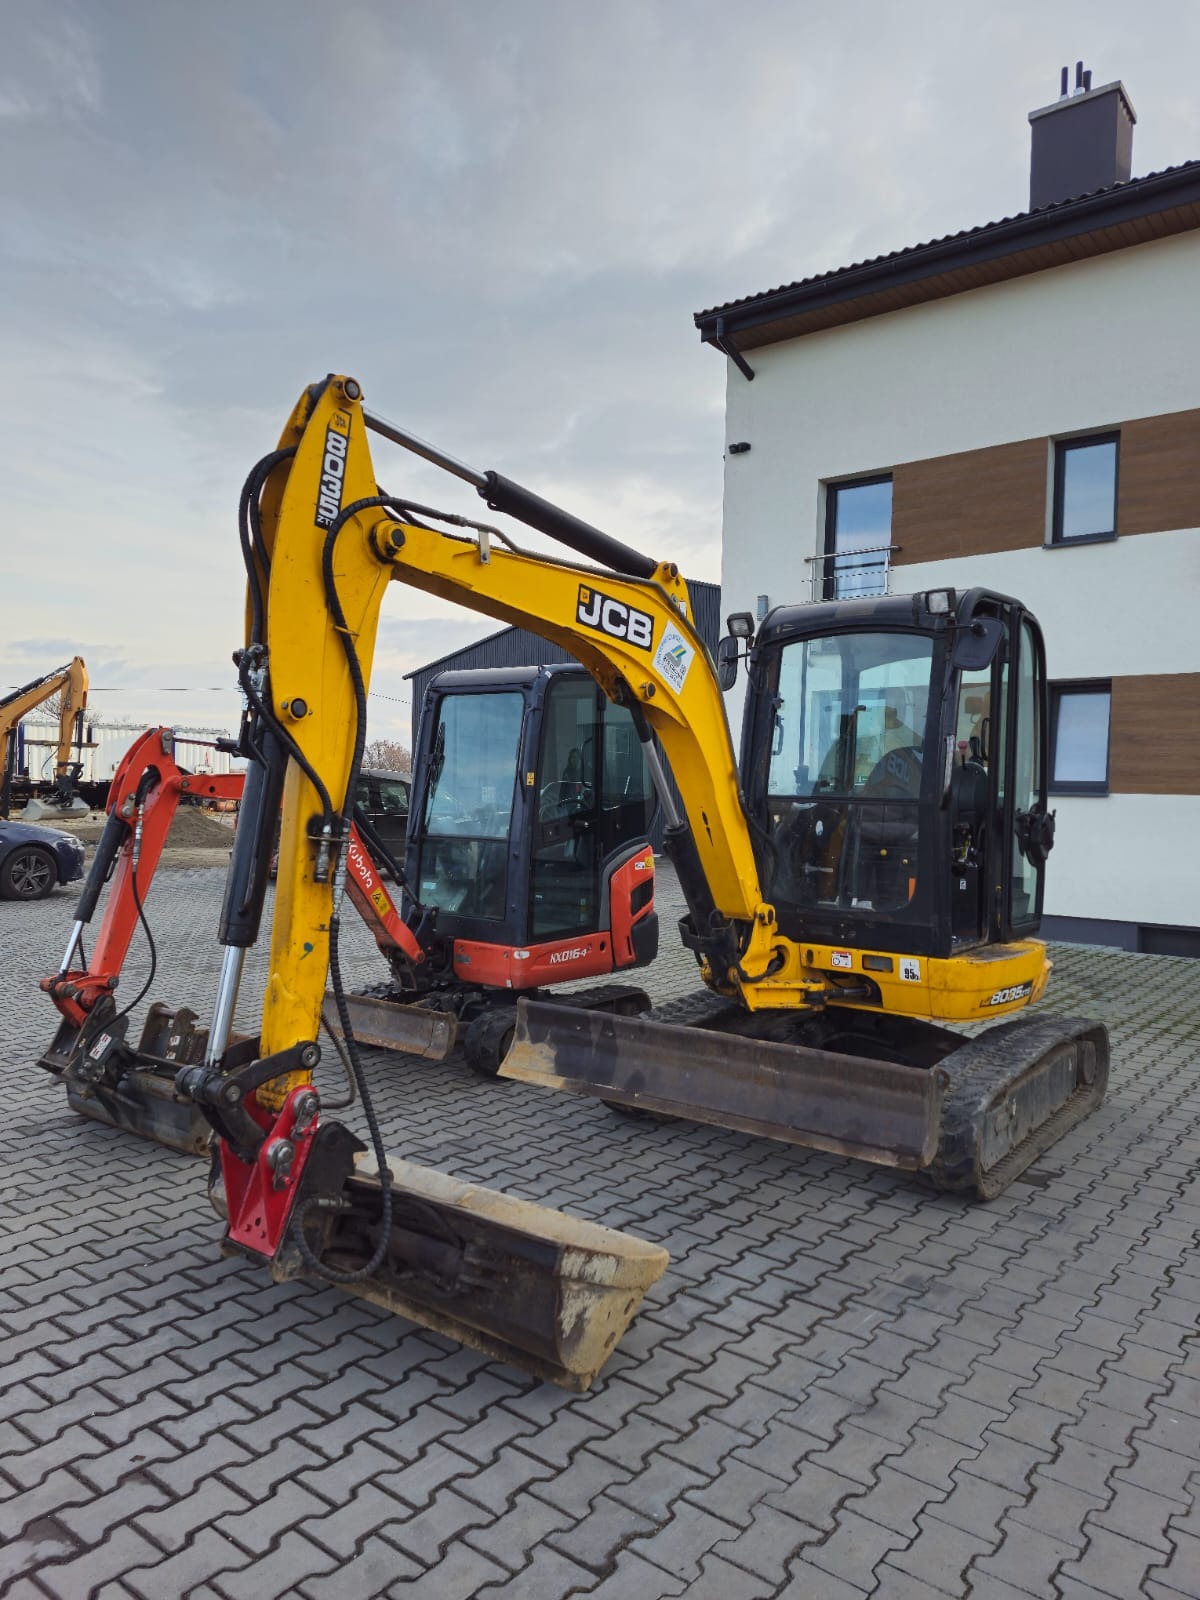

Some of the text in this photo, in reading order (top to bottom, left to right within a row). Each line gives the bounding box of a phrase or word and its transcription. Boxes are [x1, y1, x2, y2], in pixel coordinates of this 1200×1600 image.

[318, 431, 348, 520] 8035
[578, 593, 652, 647] JCB
[348, 838, 373, 888] Kubota
[904, 967, 915, 980] 95
